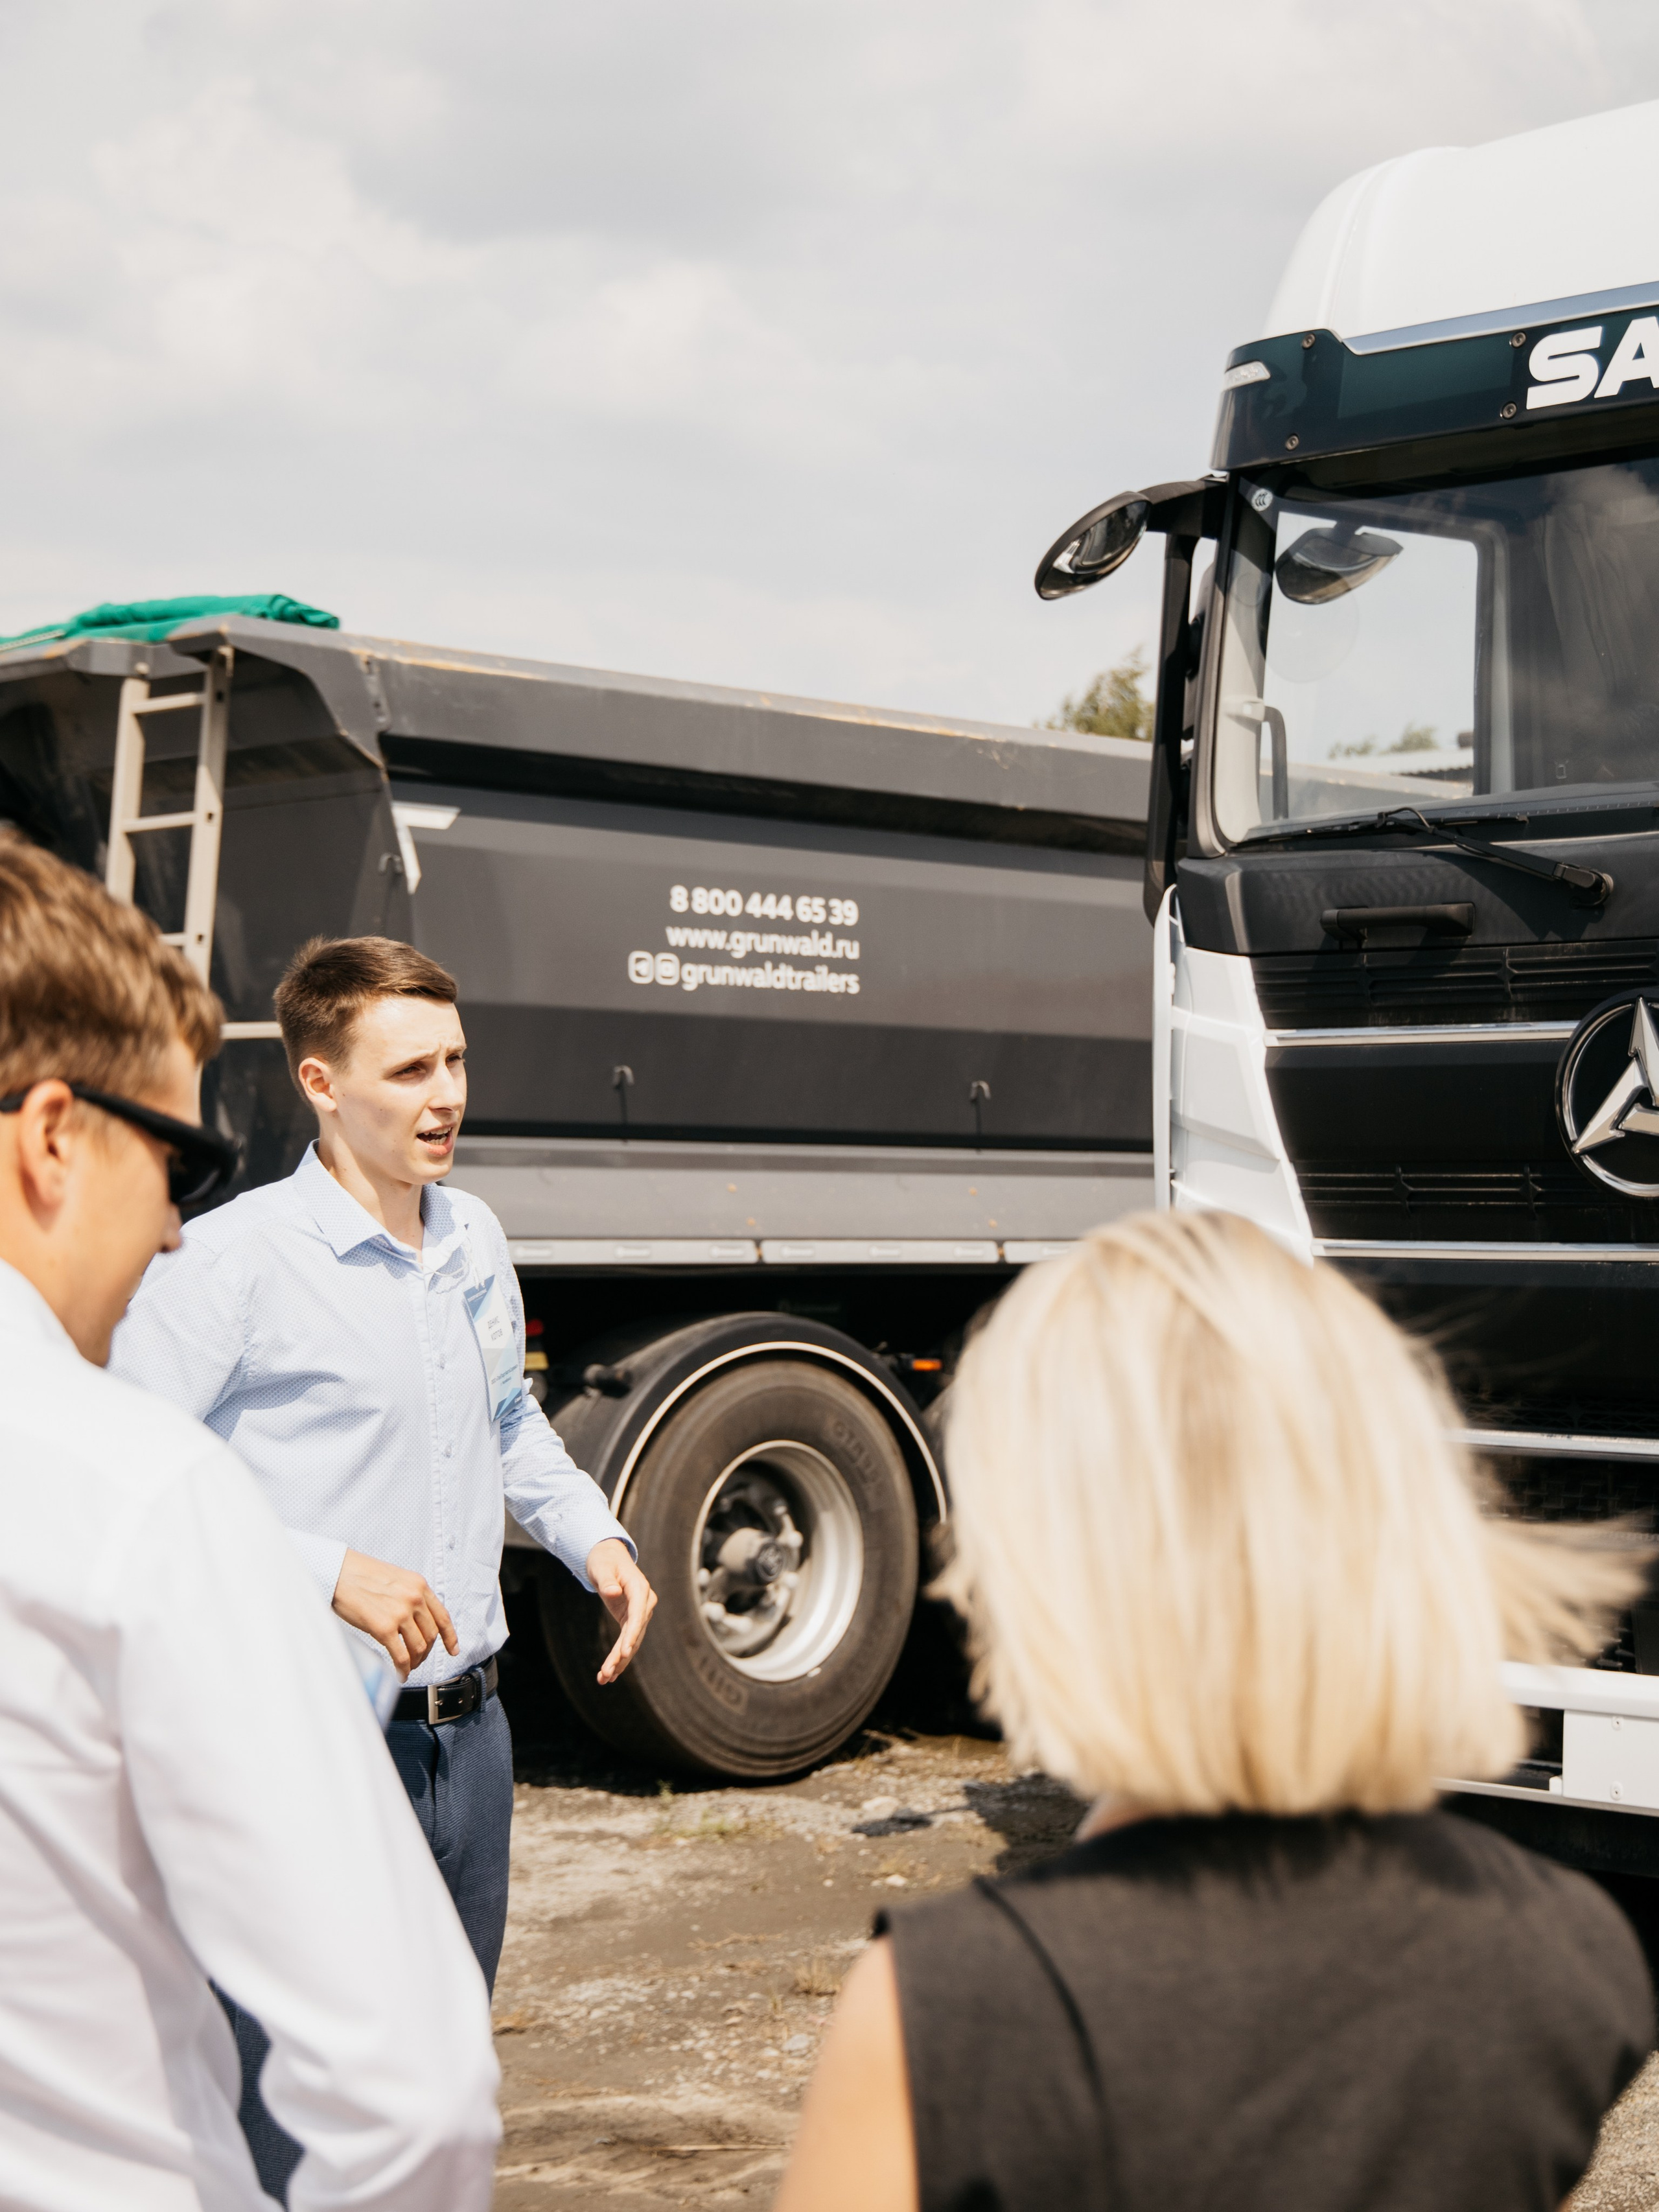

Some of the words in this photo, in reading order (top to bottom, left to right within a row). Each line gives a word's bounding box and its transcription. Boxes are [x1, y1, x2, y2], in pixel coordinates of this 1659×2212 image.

[1526, 316, 1659, 410] SA
[669, 885, 689, 913] 8
[691, 887, 743, 916] 800
[745, 891, 794, 920] 444
[795, 895, 826, 924] 65
[828, 898, 859, 926] 39
[665, 926, 860, 959] www.grunwald.ru
[680, 960, 861, 994] grunwaldtrailers
